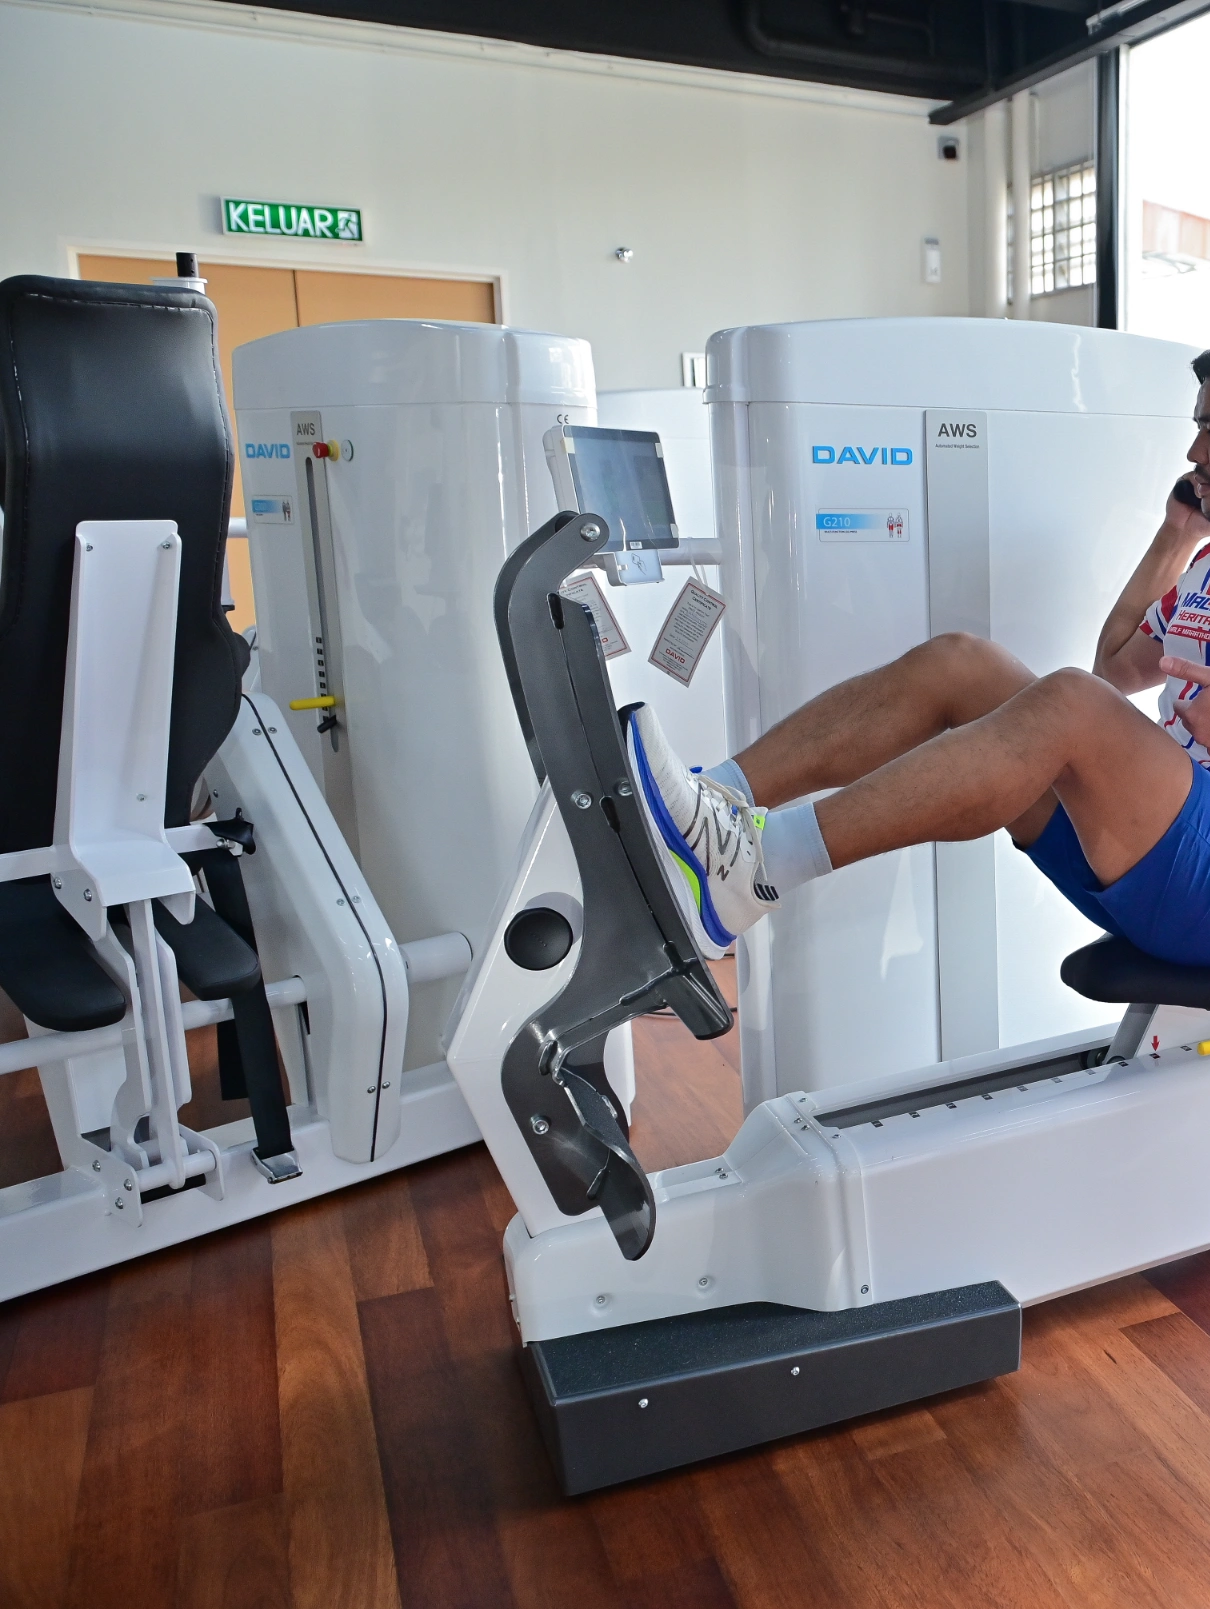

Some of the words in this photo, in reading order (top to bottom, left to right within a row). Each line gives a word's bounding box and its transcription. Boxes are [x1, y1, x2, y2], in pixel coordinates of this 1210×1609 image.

[228, 201, 334, 238] KELUAR
[296, 422, 316, 436] AWS
[937, 422, 977, 438] AWS
[245, 443, 291, 459] DAVID
[812, 445, 913, 466] DAVID
[823, 516, 851, 528] G210
[665, 648, 686, 664] DAVID
